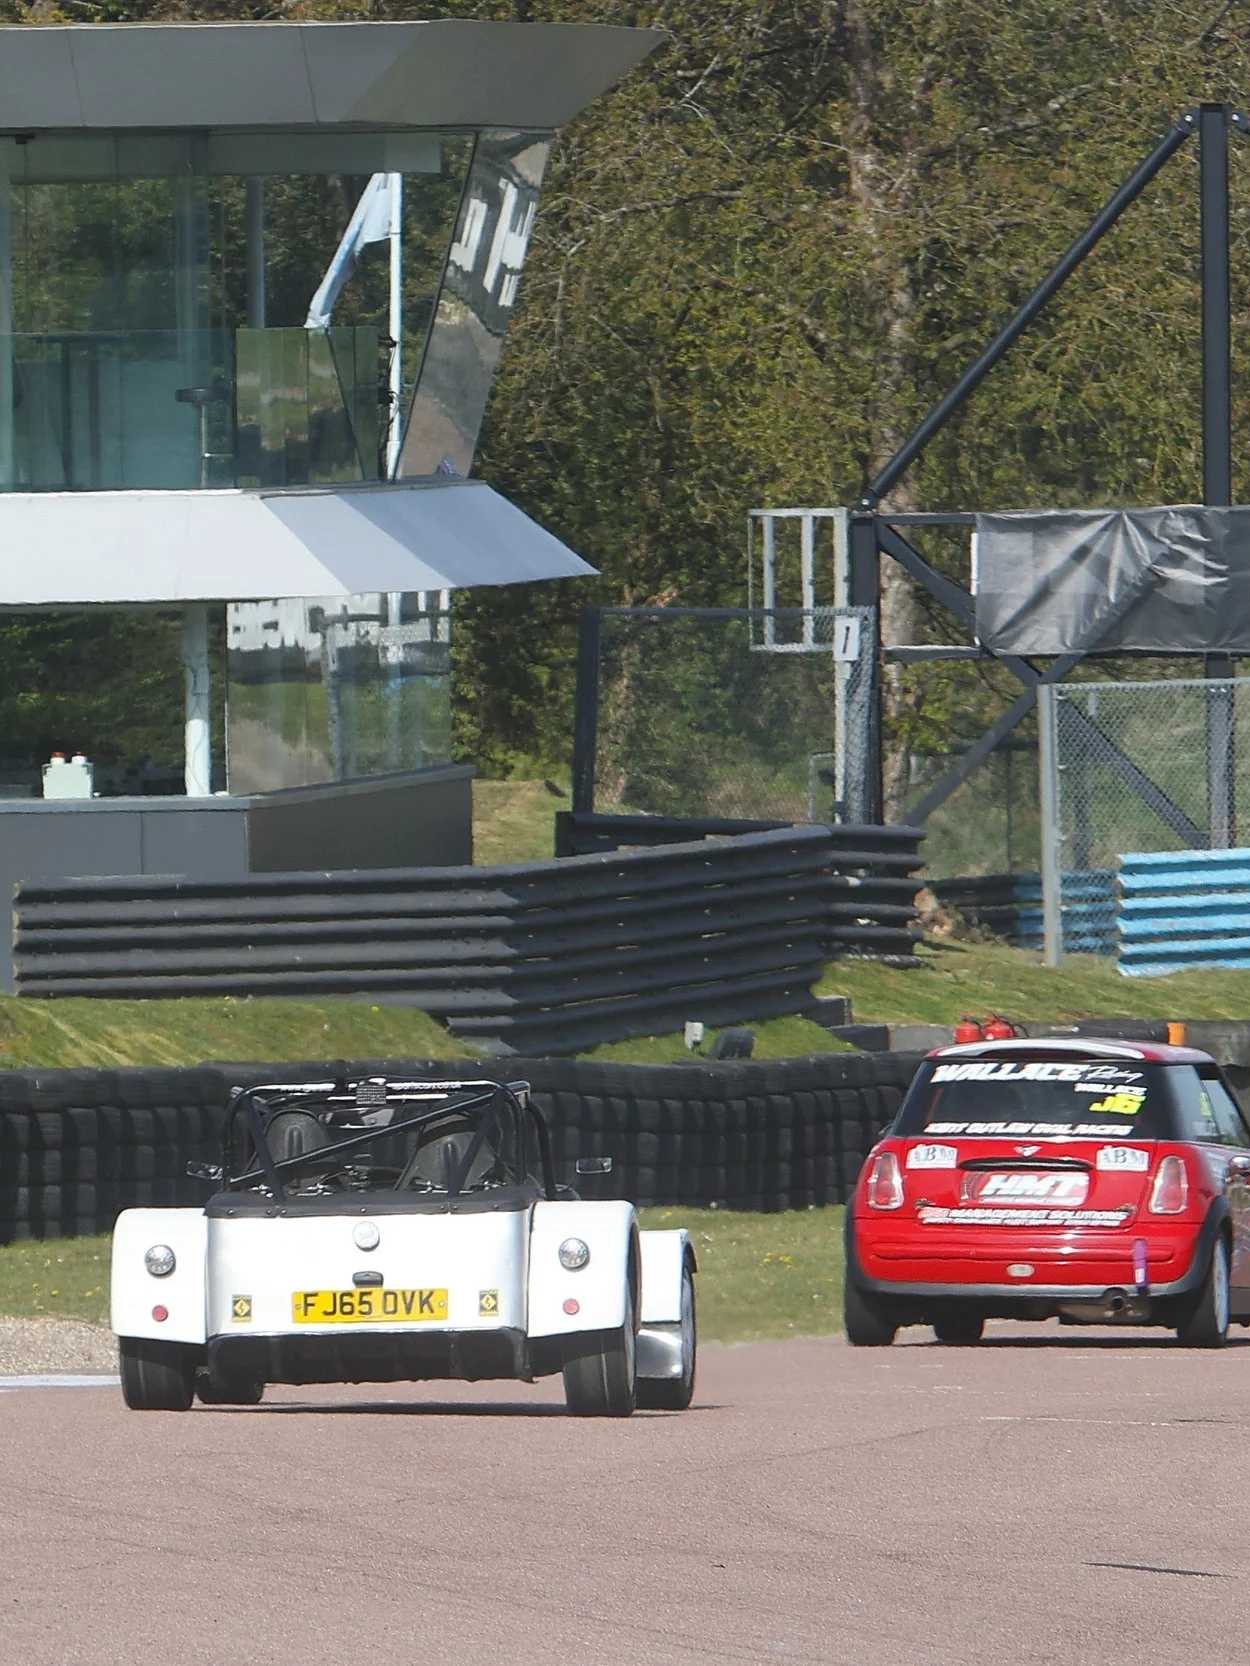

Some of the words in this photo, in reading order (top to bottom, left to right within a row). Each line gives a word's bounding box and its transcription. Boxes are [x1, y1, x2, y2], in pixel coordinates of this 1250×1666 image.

[931, 1063, 1090, 1083] WALLACE
[978, 1174, 1090, 1197] HMT
[302, 1291, 373, 1317] FJ65
[382, 1290, 435, 1315] OVK
